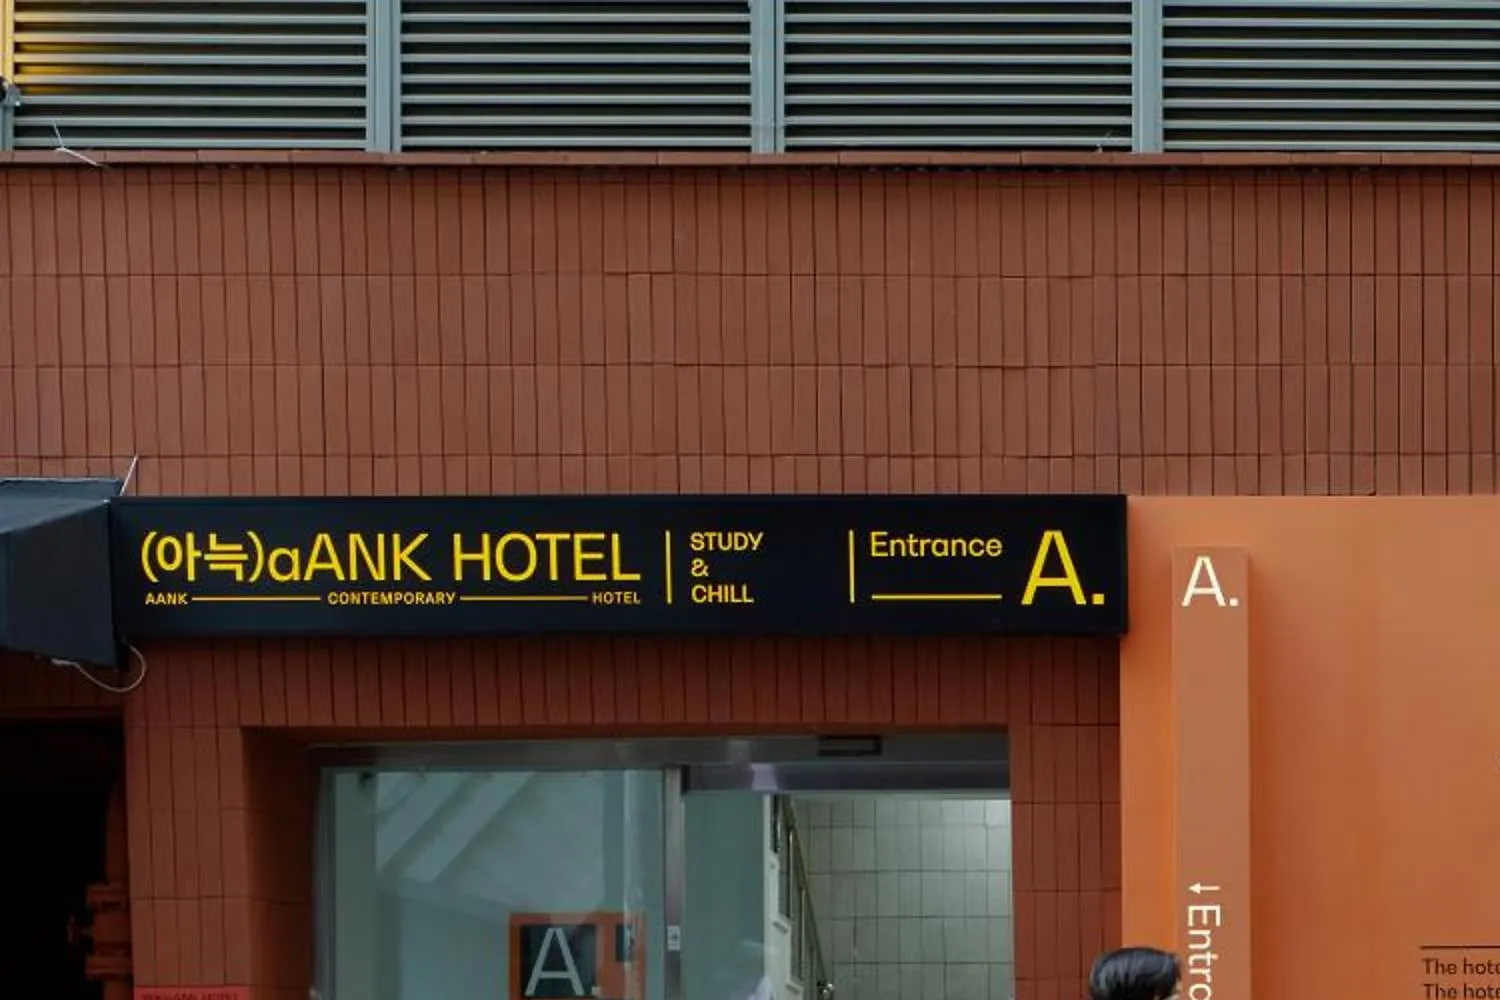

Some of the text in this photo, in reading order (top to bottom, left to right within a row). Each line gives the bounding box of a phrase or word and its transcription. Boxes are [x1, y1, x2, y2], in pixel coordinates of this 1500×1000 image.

[690, 531, 764, 551] STUDY
[870, 531, 1003, 557] Entrance
[453, 532, 641, 582] HOTEL
[690, 557, 709, 578] &
[1021, 530, 1105, 606] A.
[1181, 556, 1239, 607] A.
[145, 592, 641, 605] AANK CONTEMPORARY HOTEL
[691, 584, 755, 604] CHILL
[524, 927, 602, 997] A.
[1422, 957, 1458, 976] The
[1423, 982, 1458, 1000] The
